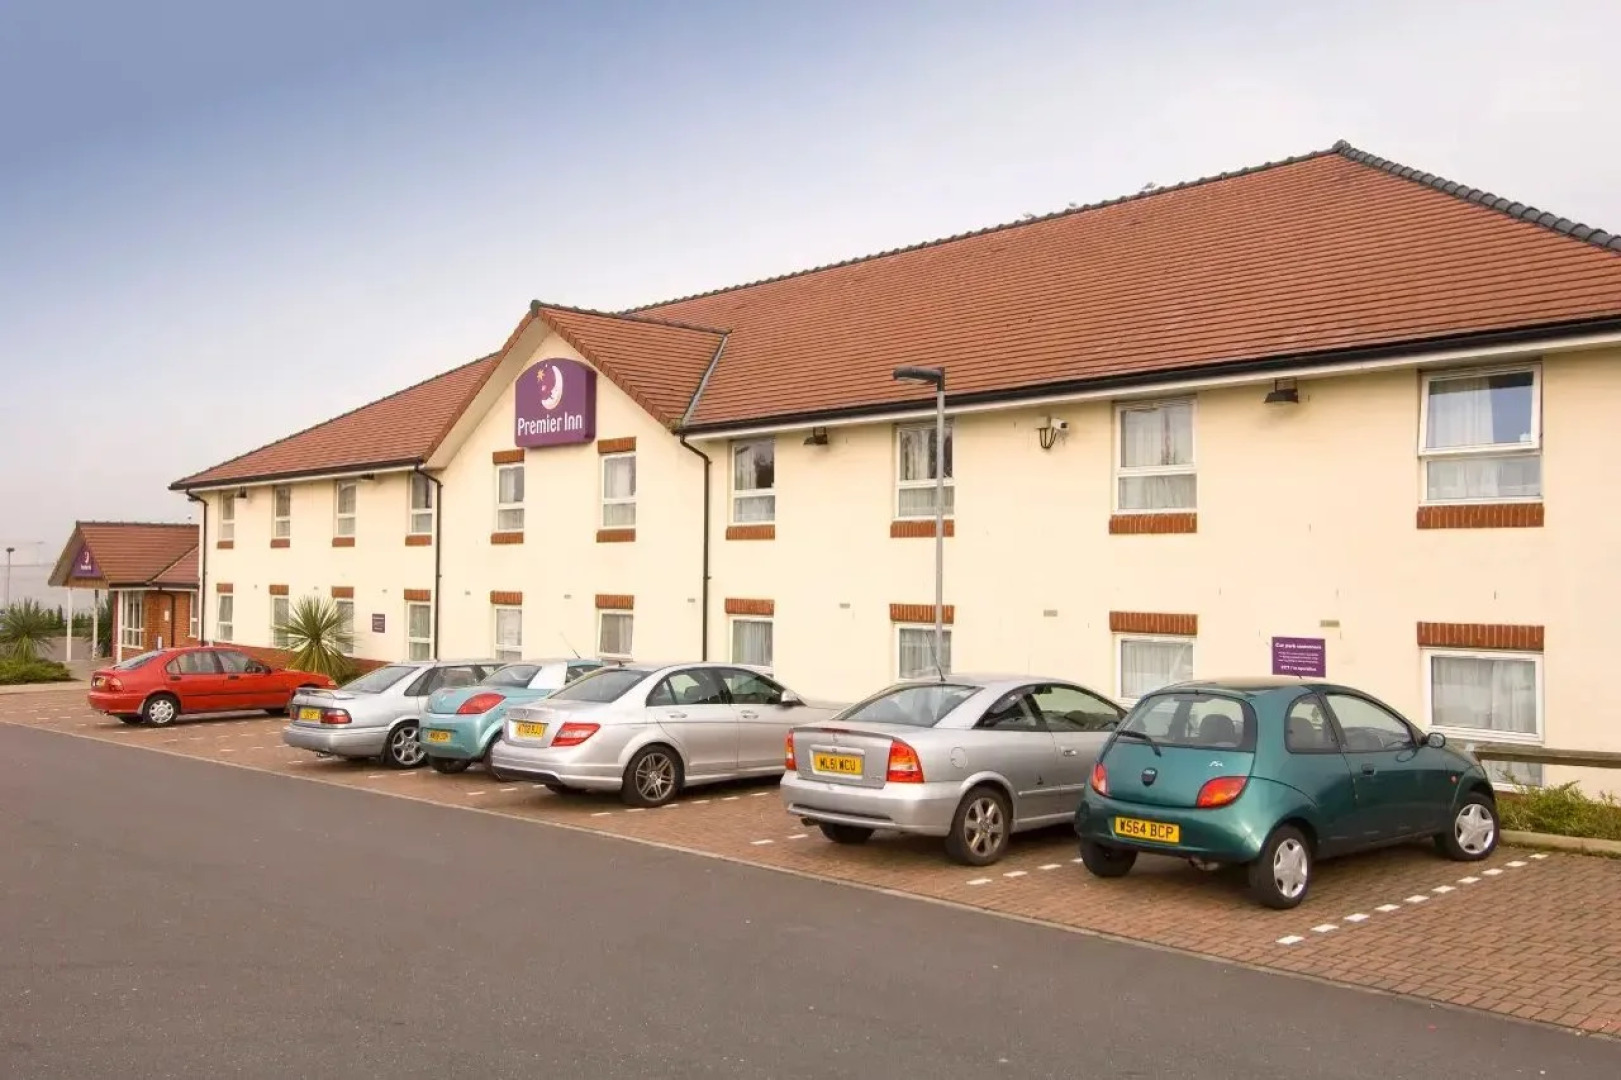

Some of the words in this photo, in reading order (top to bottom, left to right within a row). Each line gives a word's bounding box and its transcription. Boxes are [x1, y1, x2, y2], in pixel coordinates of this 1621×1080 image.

[517, 414, 563, 436] Premier
[564, 411, 583, 431] Inn
[1120, 819, 1147, 835] W564
[1150, 823, 1174, 839] BCP
